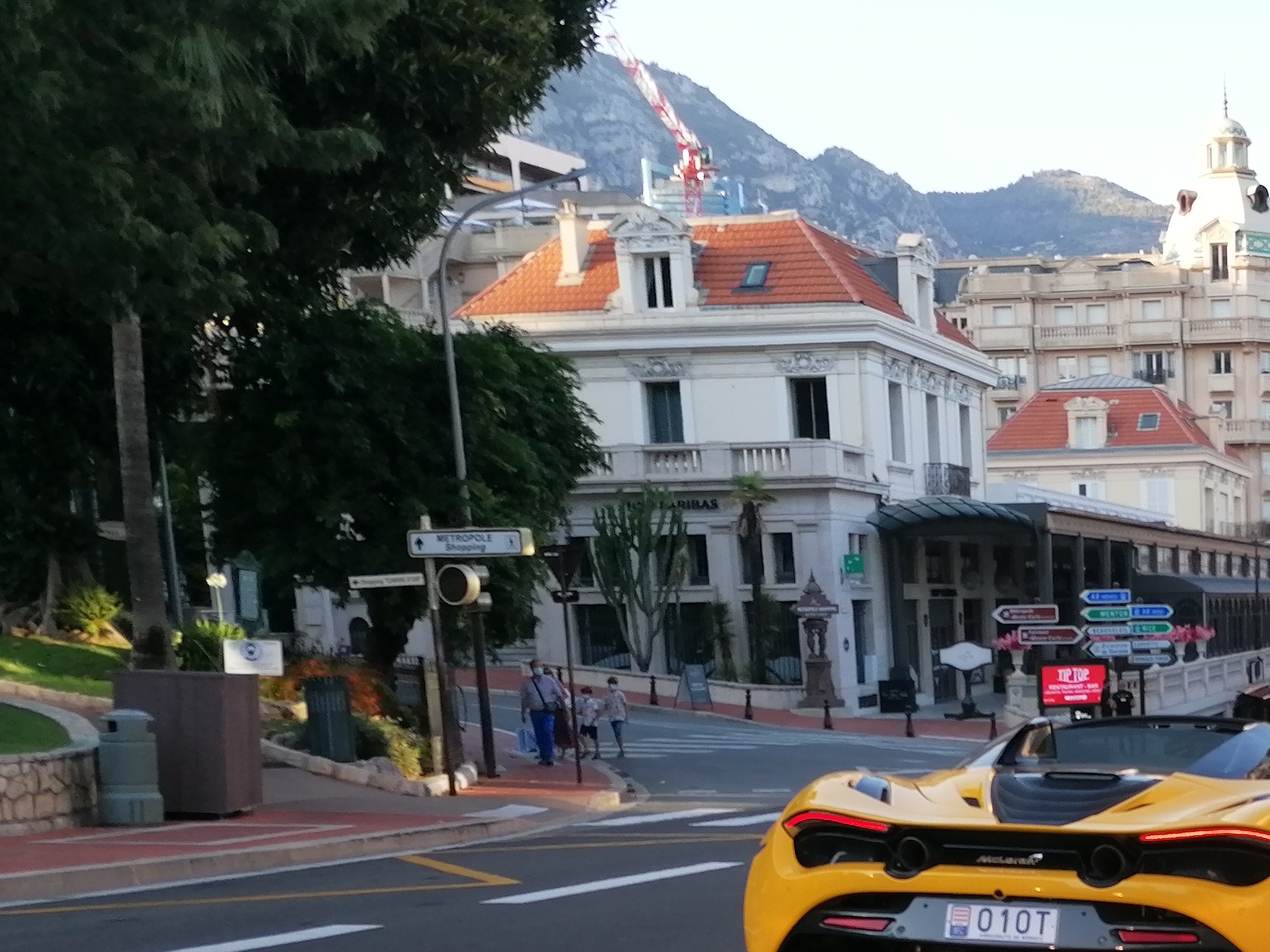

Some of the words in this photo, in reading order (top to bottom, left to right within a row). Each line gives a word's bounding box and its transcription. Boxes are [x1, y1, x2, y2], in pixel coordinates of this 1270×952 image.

[436, 533, 493, 543] METROPOLE
[445, 543, 486, 553] Shopping
[1057, 668, 1071, 682] TIP
[1072, 667, 1090, 682] TOP
[977, 907, 1051, 935] 010T
